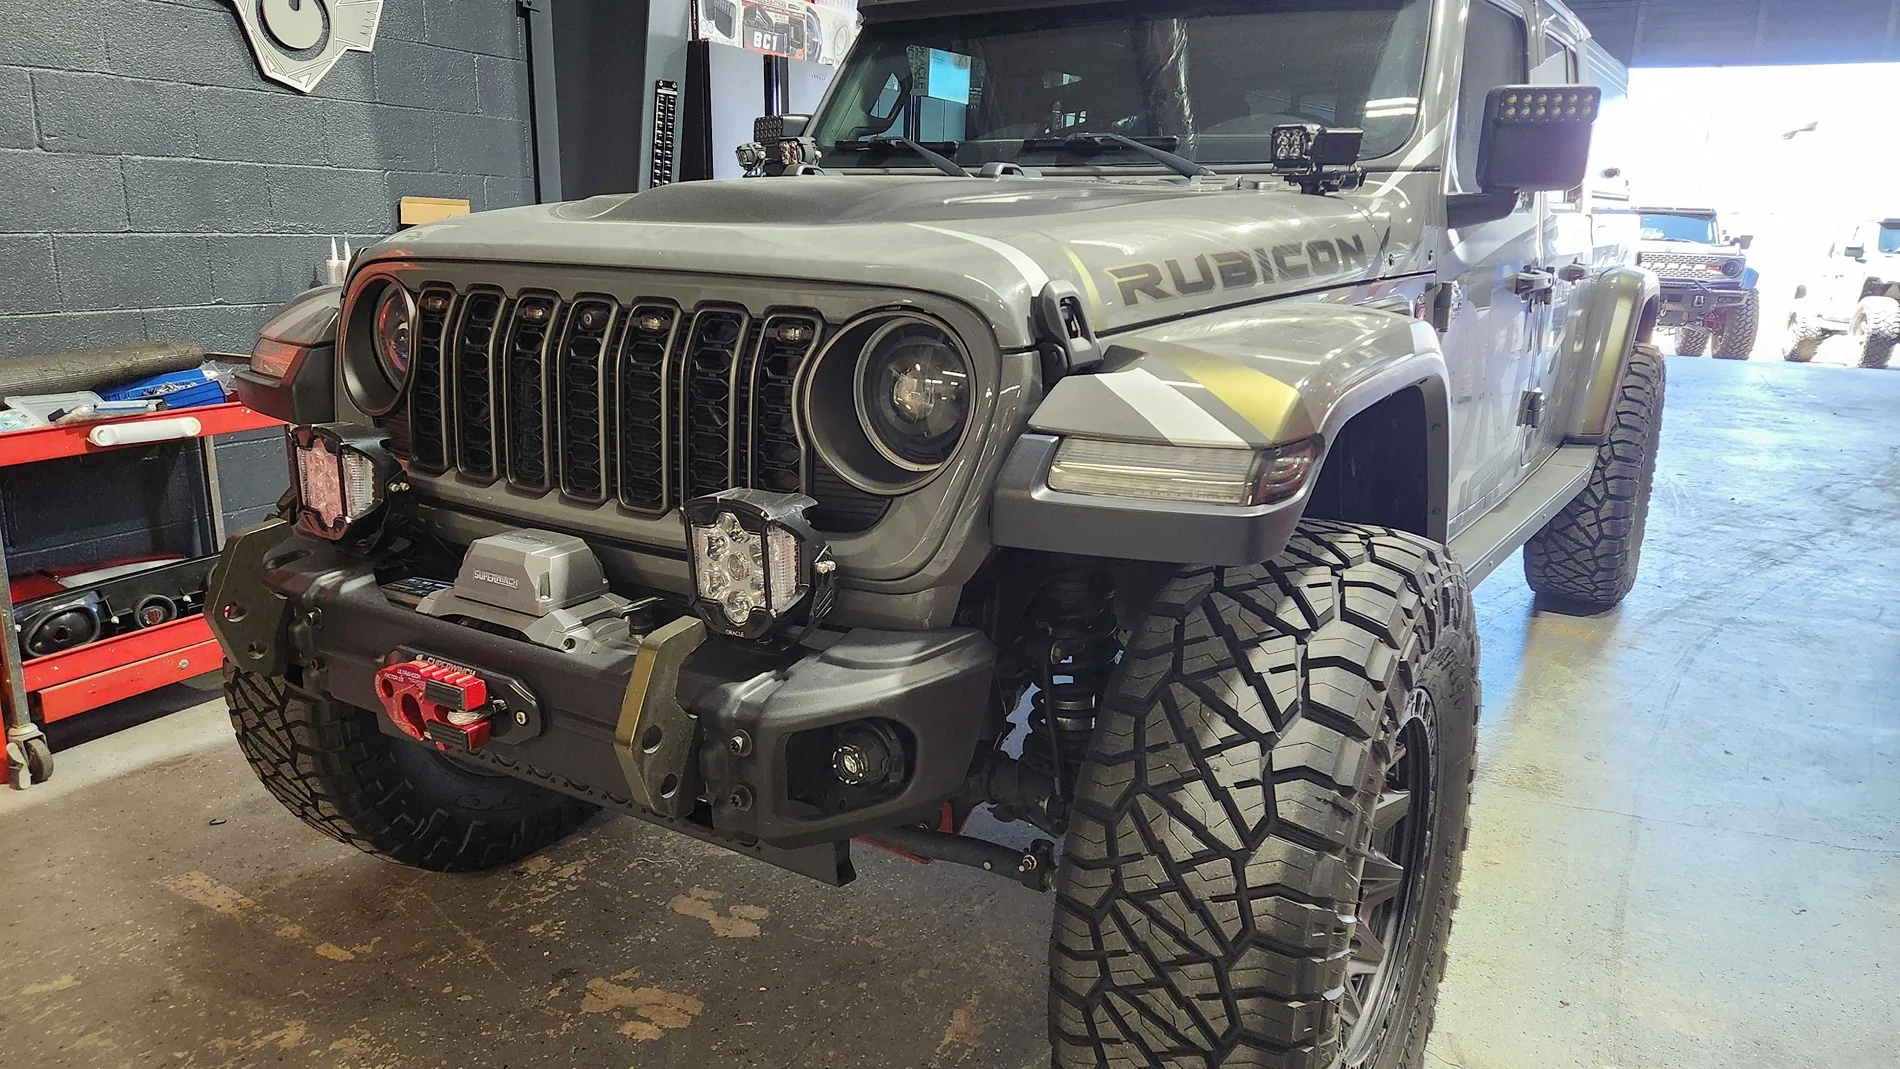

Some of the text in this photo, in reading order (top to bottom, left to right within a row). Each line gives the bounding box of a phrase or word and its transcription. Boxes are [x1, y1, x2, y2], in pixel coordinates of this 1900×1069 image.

[753, 31, 778, 51] BC1
[1104, 233, 1369, 306] RUBICON
[474, 569, 518, 589] SUPERWINCH
[725, 629, 745, 638] ORACLE
